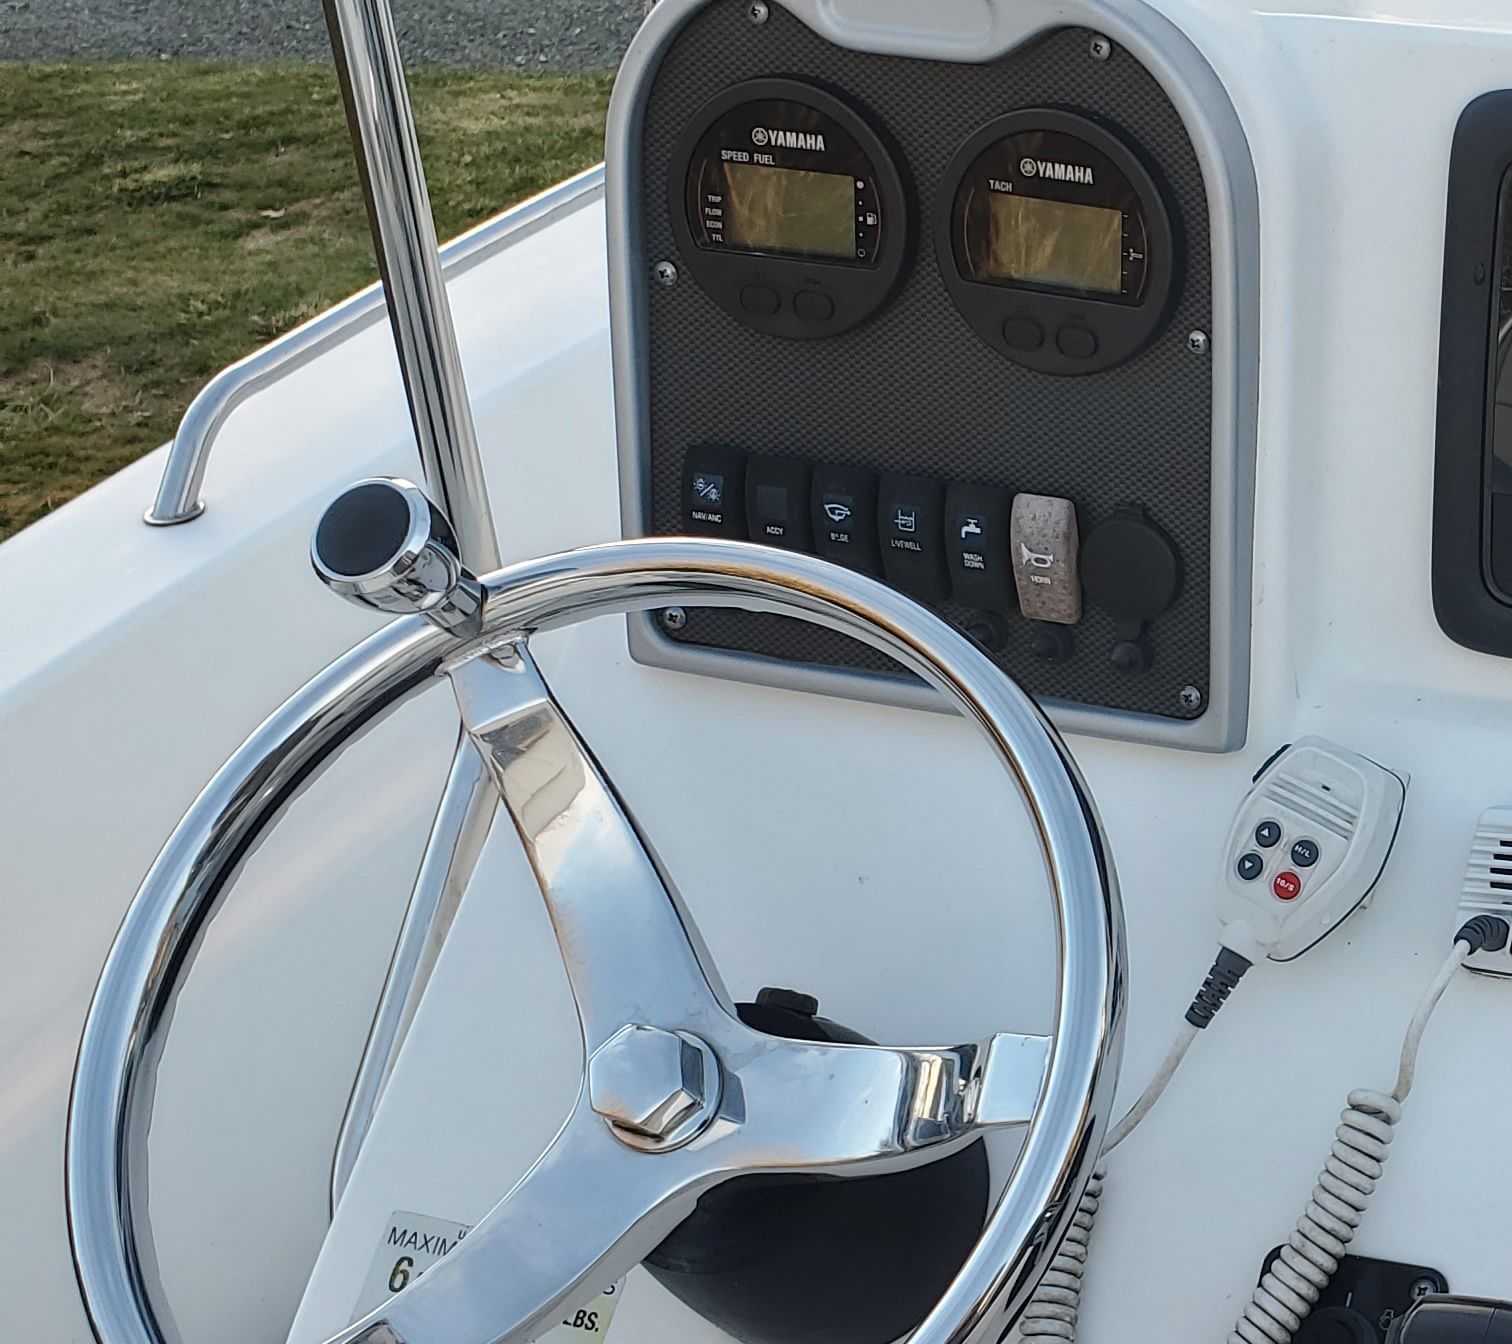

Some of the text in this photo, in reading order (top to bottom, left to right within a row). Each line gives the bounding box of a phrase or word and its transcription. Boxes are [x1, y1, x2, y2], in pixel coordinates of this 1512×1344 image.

[768, 129, 825, 152] YAMAHA
[721, 150, 775, 165] SPEED FUEL
[1037, 160, 1094, 184] YAMAHA
[989, 179, 1012, 192] TACH
[1294, 844, 1311, 858] H/L
[387, 1226, 458, 1256] MAXIM
